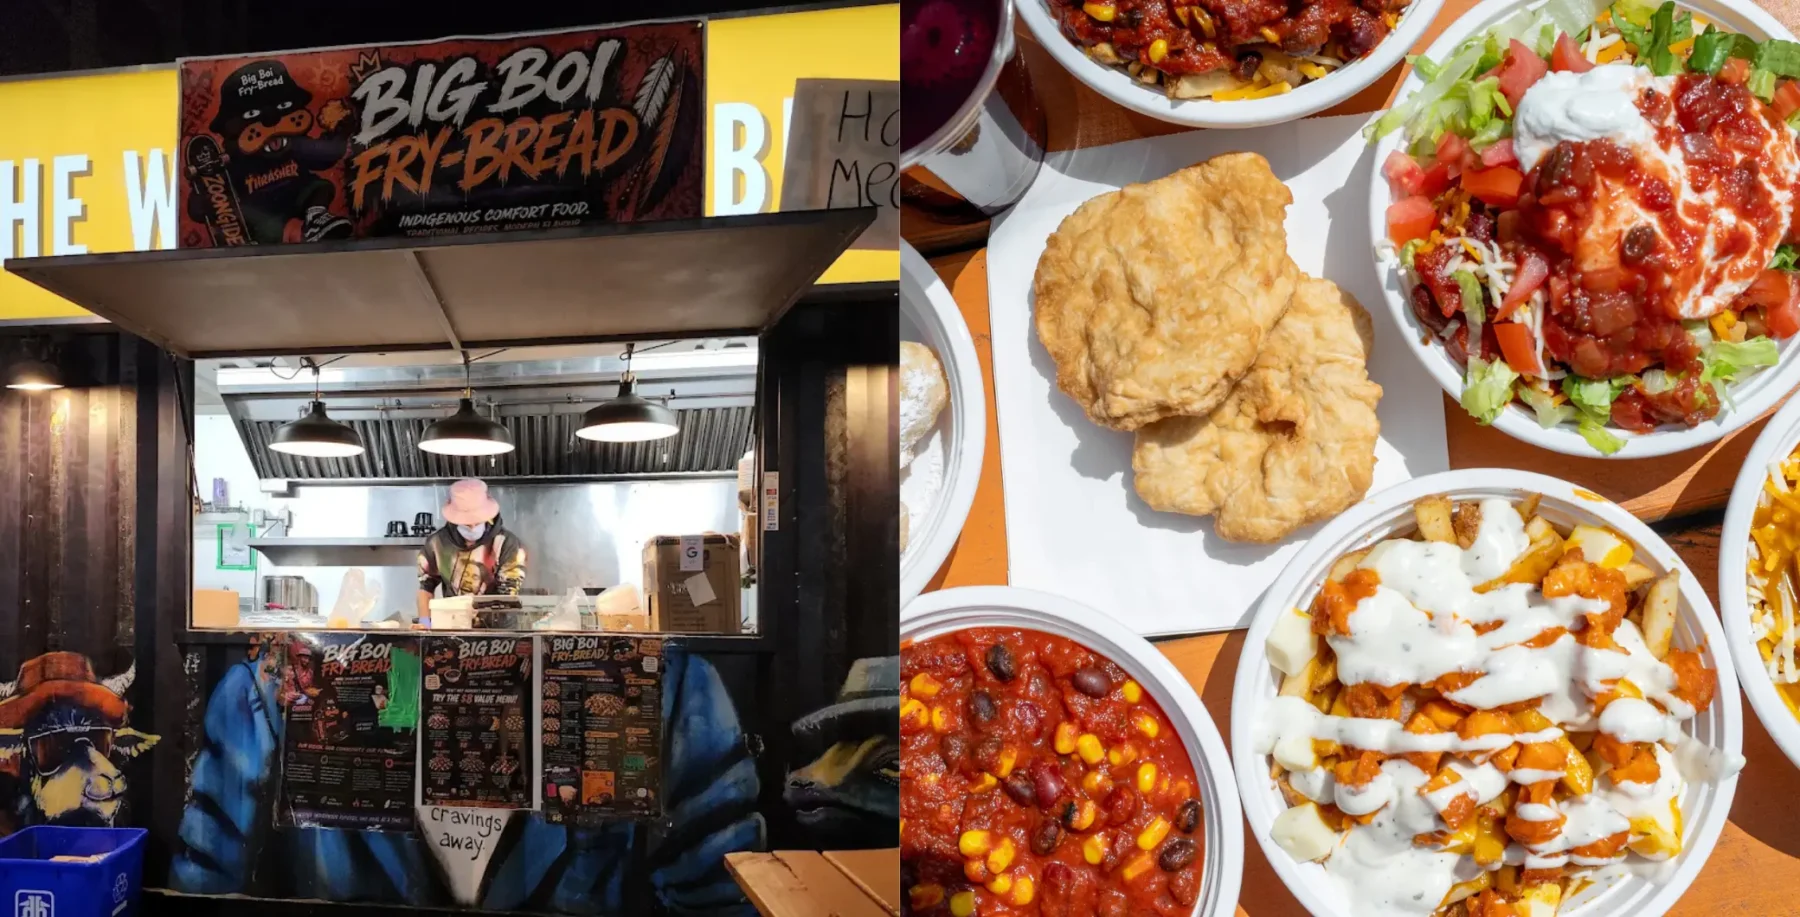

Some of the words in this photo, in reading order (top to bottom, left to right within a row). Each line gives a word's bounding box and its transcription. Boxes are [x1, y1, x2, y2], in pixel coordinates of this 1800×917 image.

[238, 75, 284, 97] Fry-Bread
[241, 73, 259, 87] Big
[259, 68, 274, 80] Boi
[352, 57, 488, 147] BIG
[487, 39, 621, 114] BOI
[350, 107, 640, 207] FRY-BREAD
[245, 160, 299, 194] THRASHER
[399, 209, 481, 227] INDIGENOUS
[484, 203, 550, 222] COMFORT
[551, 201, 590, 217] FOOD.
[322, 643, 359, 664] BIG
[359, 642, 393, 661] BOI
[457, 640, 489, 660] BIG
[489, 638, 516, 656] BOI
[551, 648, 605, 662] FRY-BREAD
[553, 637, 575, 652] BIG
[577, 636, 598, 649] BOI
[459, 654, 518, 672] FRY-BREAD
[432, 692, 447, 703] TRY
[447, 693, 460, 703] THE
[474, 694, 495, 704] VALUE
[431, 807, 502, 837] cravings
